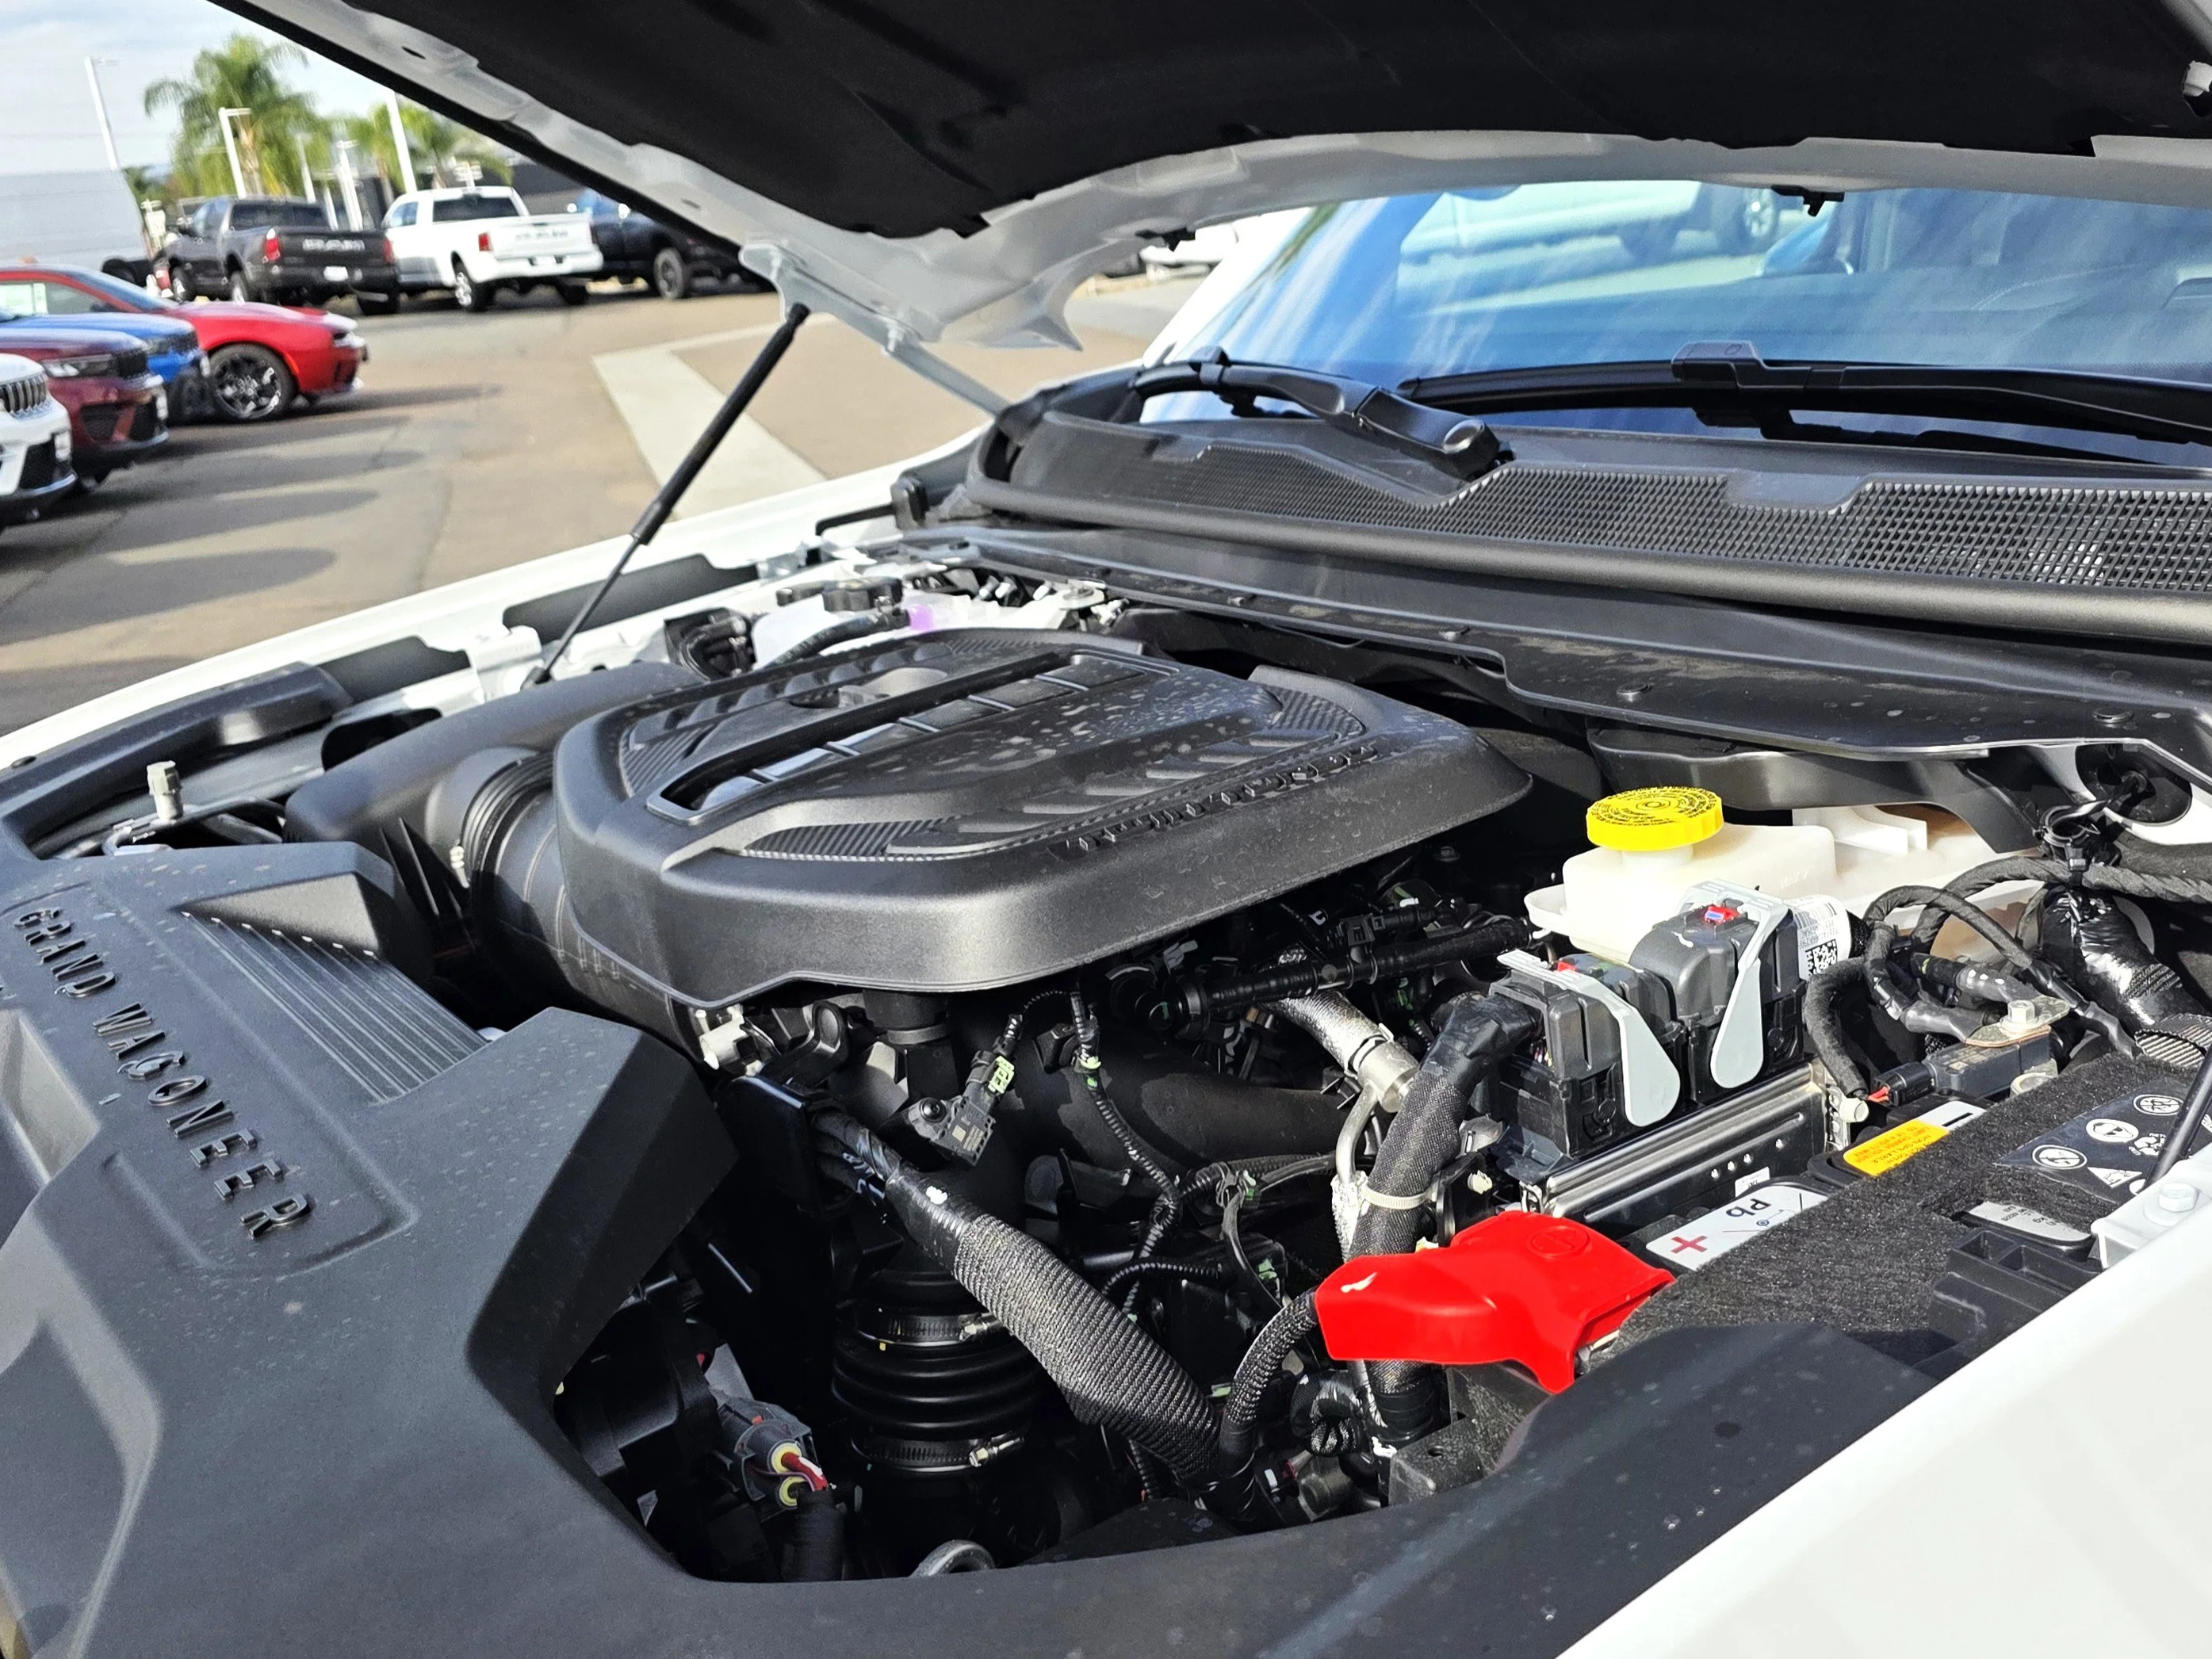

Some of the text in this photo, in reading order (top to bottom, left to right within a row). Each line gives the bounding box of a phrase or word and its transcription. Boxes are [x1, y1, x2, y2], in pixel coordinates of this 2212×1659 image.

[13, 908, 117, 998] GRAND
[91, 1003, 312, 1239] WAGONEER
[1725, 1198, 1772, 1217] Pb
